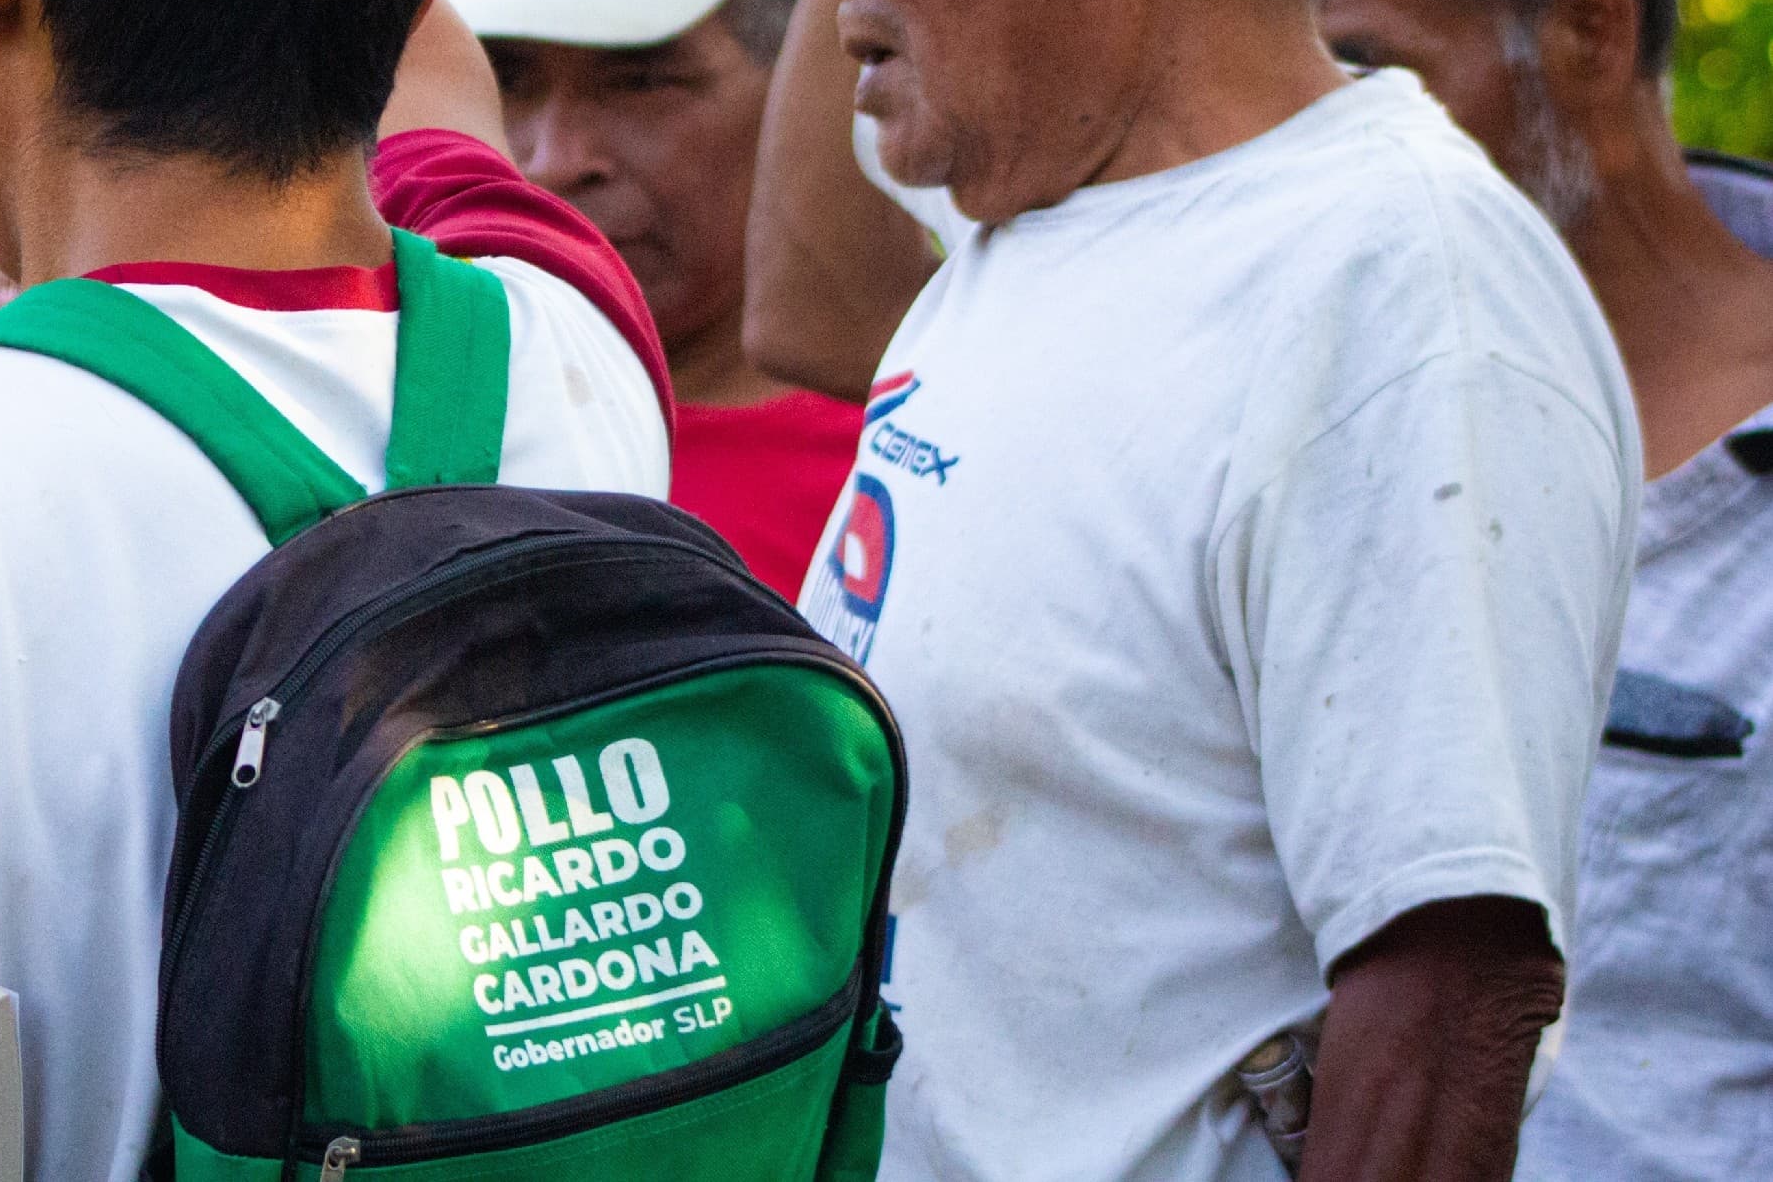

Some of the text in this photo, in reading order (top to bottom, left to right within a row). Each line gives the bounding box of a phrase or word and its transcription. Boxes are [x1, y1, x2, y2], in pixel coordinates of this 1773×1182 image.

[430, 738, 670, 860] POLLO
[442, 827, 686, 914] RICARDO
[459, 882, 703, 965] GALLARDO
[473, 931, 720, 1015] CARDONA
[493, 996, 733, 1071] Gobernador SLP
